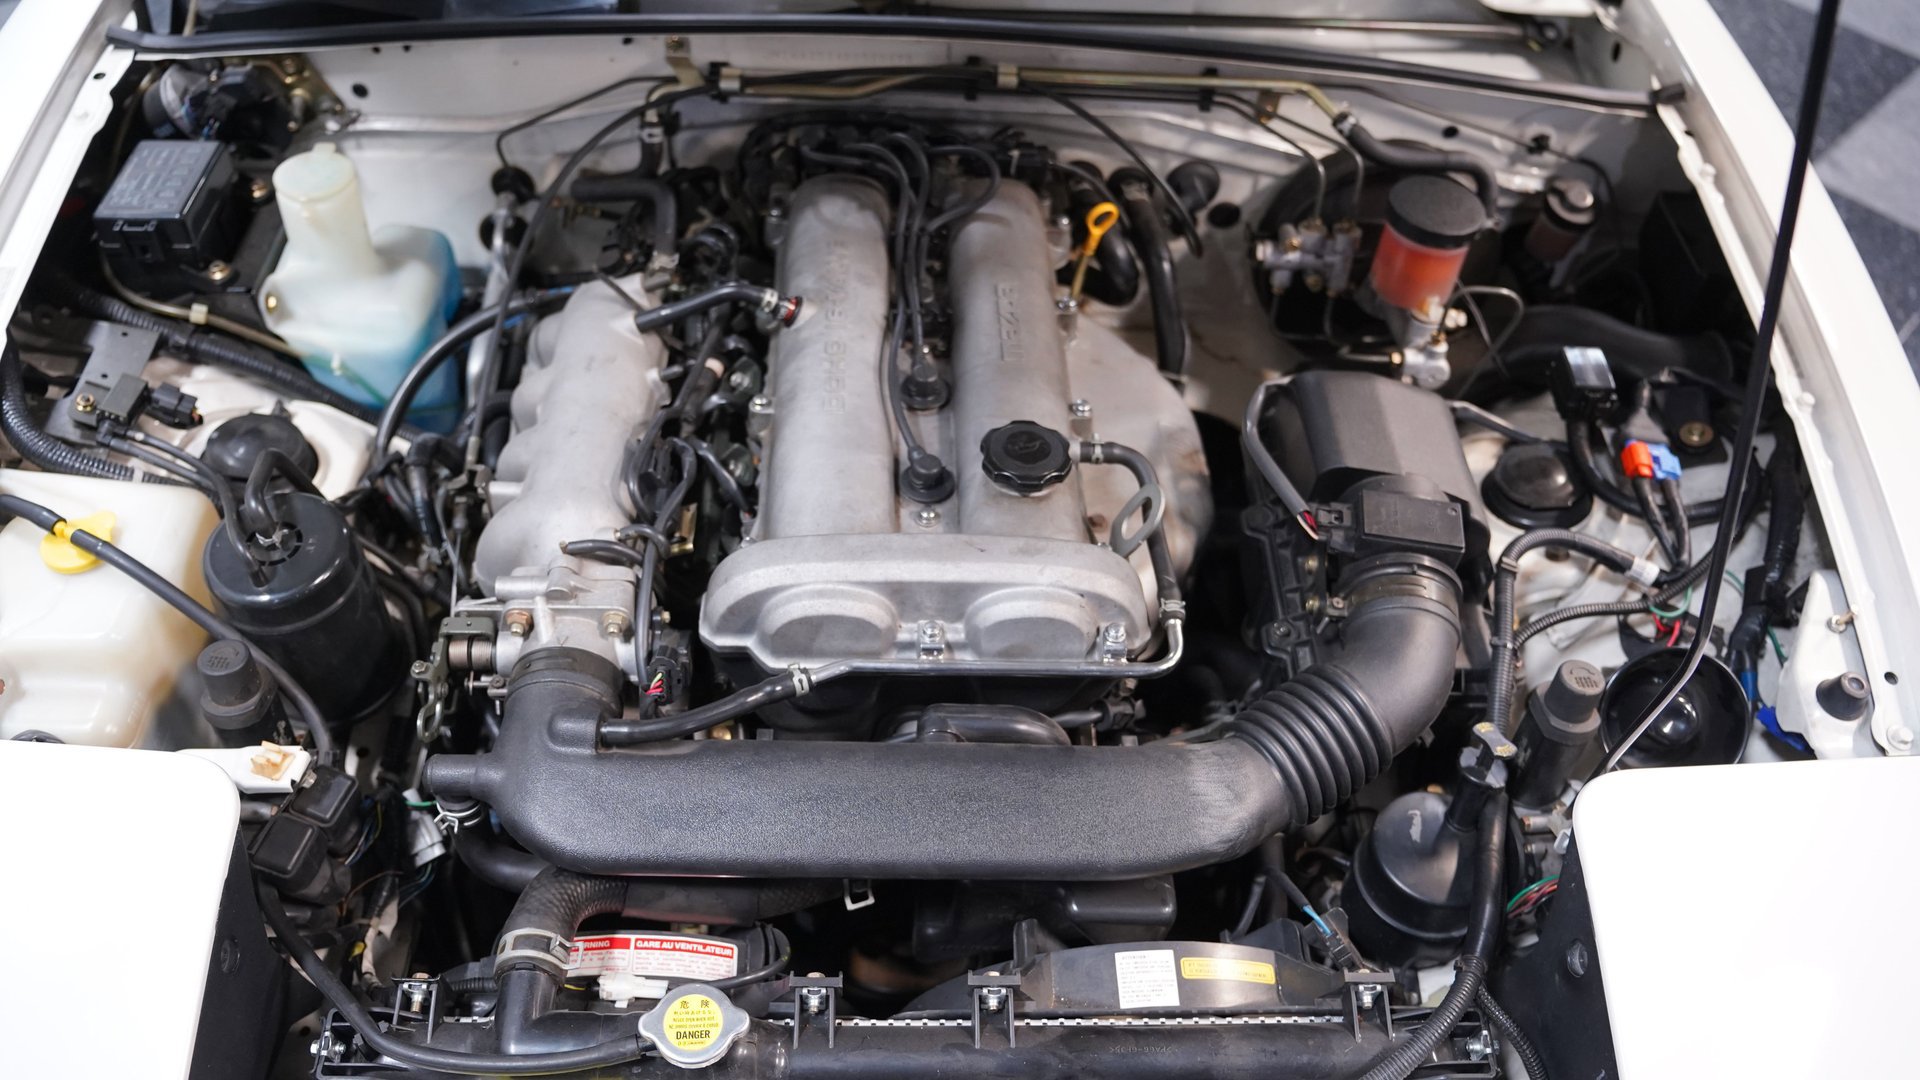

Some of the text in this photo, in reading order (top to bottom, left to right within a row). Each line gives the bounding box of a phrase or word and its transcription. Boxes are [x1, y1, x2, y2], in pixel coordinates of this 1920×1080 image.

[662, 941, 673, 949] AU
[675, 942, 732, 955] VENTILATEUR
[676, 1030, 710, 1039] DANGER
